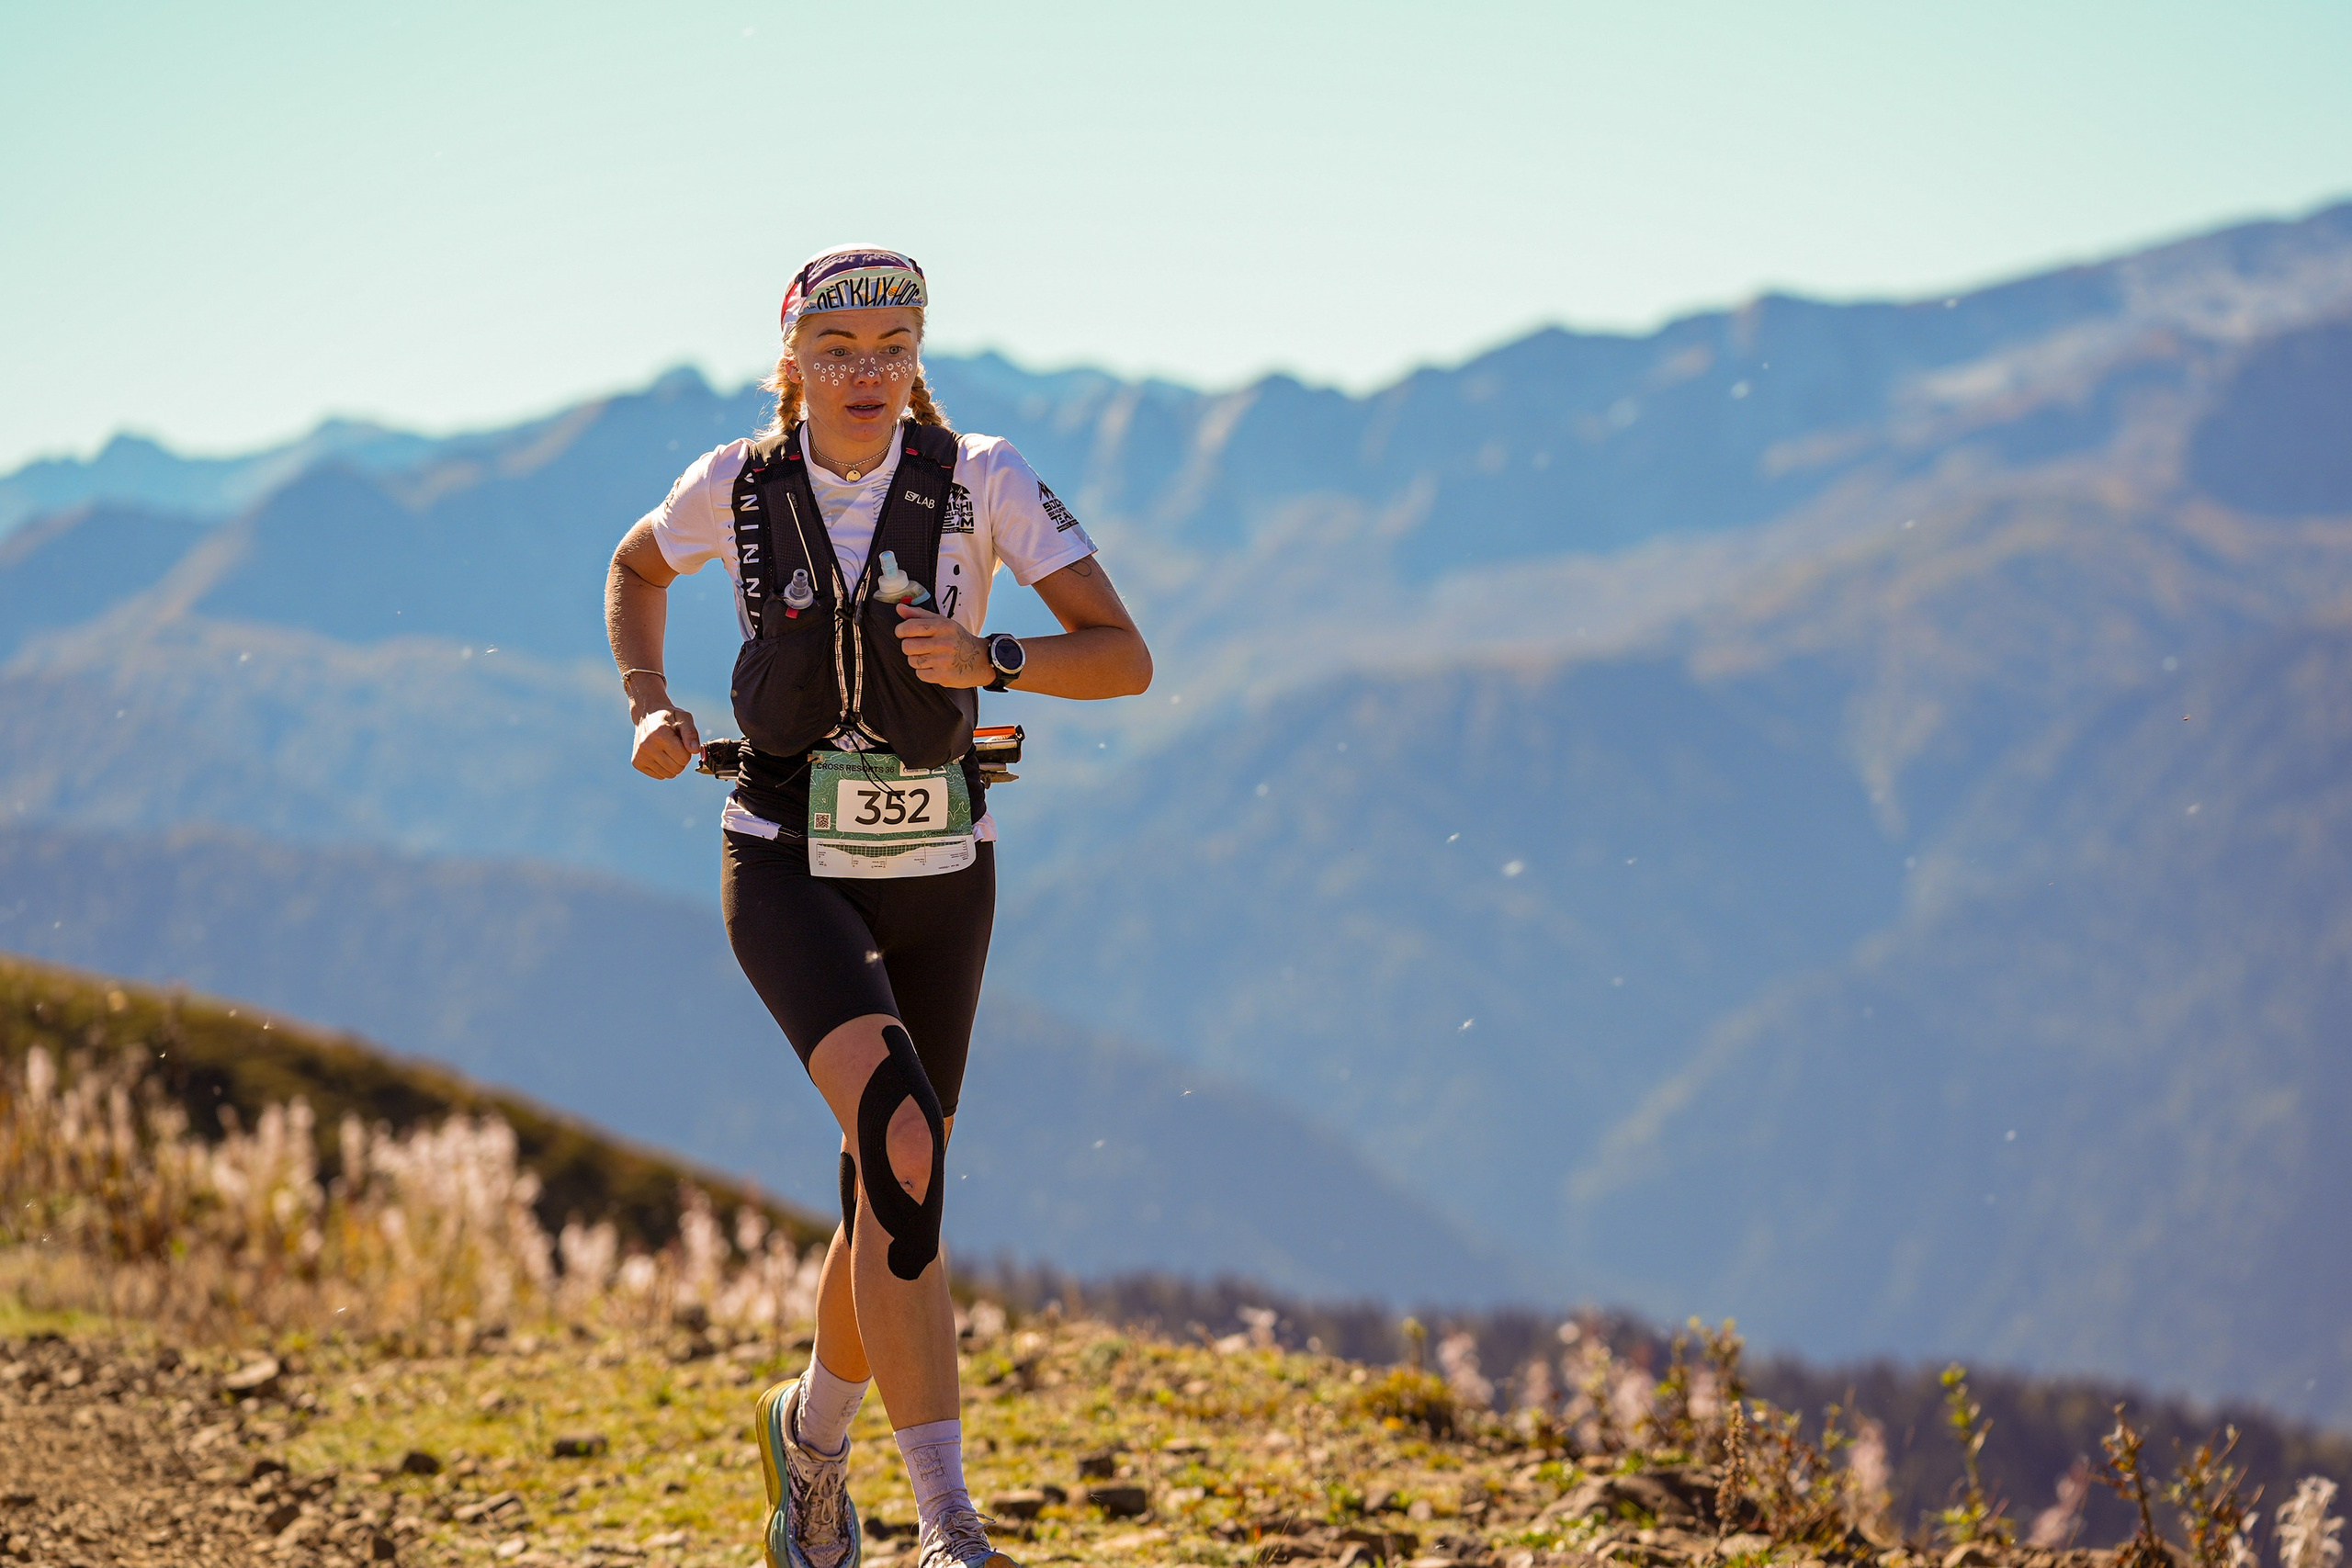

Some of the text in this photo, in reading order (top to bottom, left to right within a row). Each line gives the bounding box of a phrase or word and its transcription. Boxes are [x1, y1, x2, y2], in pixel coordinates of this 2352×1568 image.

[816, 762, 844, 772] CROSS
[845, 764, 884, 773] RESORTS
[854, 788, 930, 826] 352
